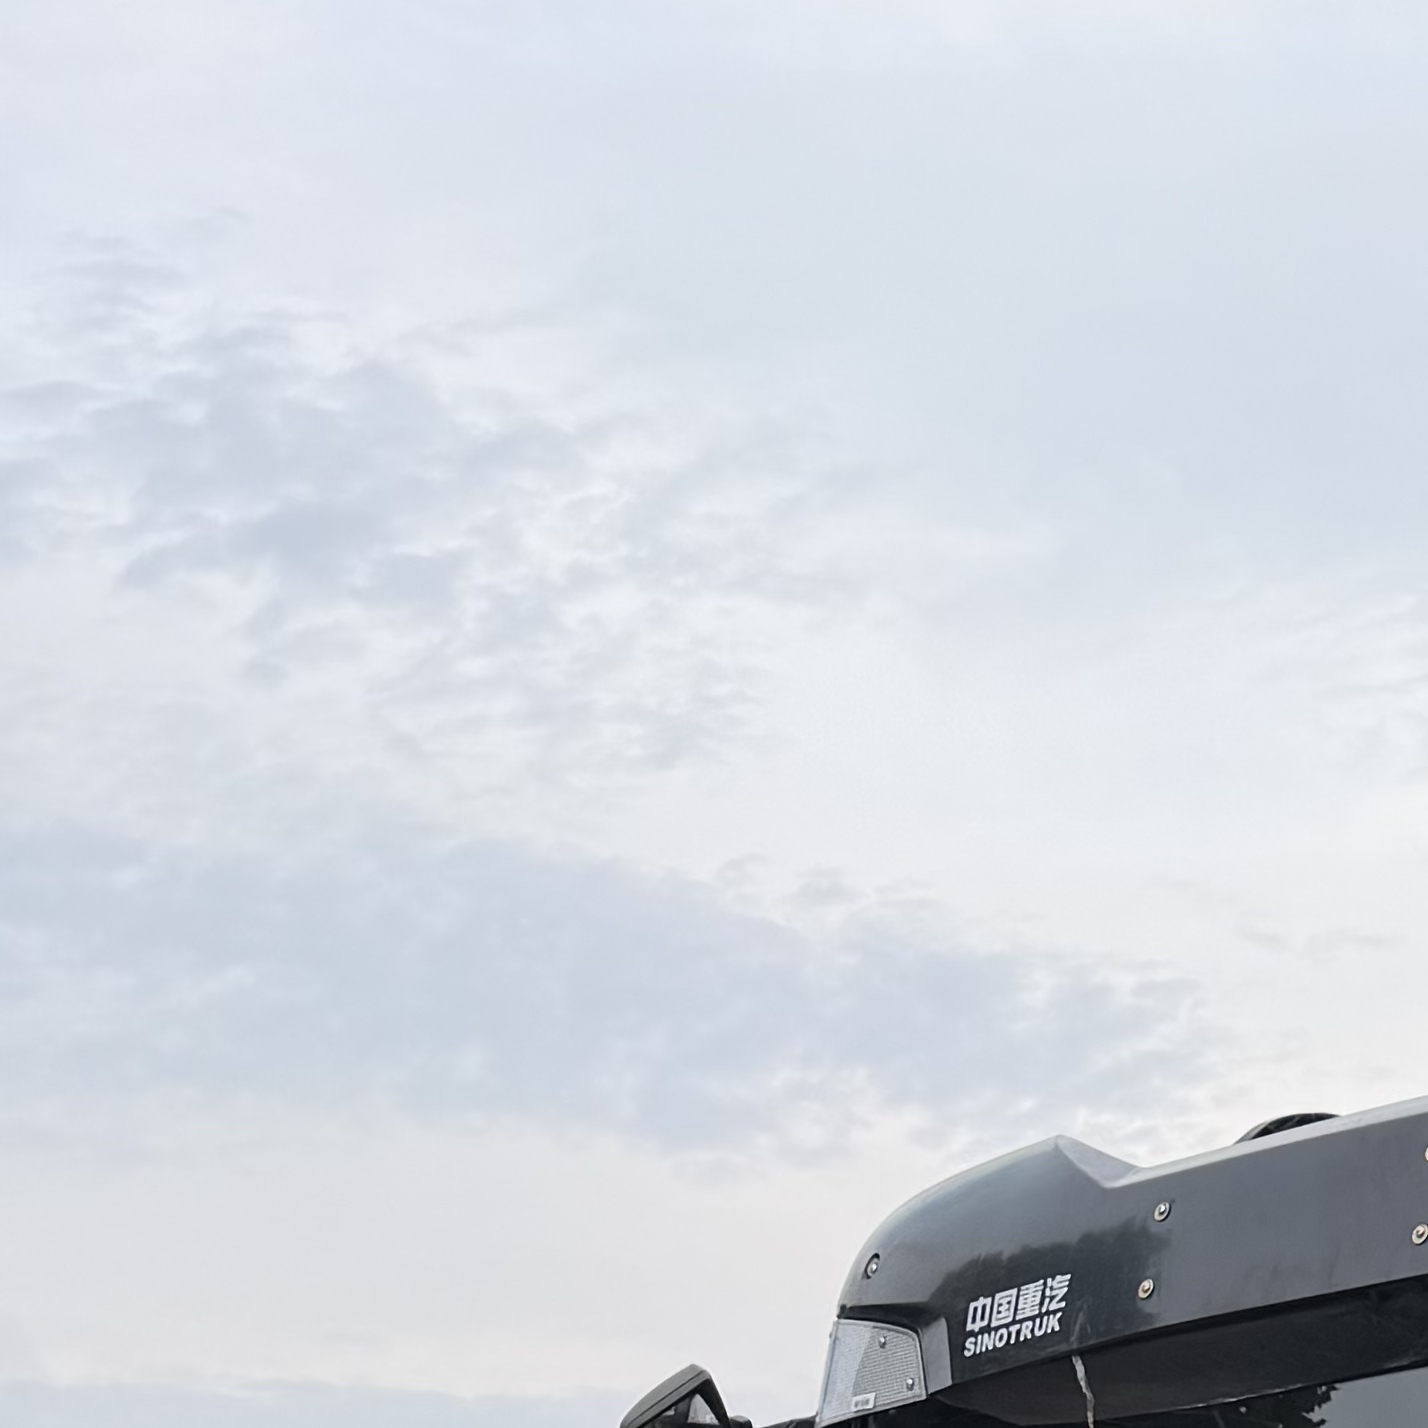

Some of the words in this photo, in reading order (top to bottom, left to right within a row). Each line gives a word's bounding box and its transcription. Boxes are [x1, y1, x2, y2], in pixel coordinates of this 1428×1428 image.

[966, 1273, 1071, 1333] 中国重汽
[963, 1311, 1063, 1358] SINOTRUK
